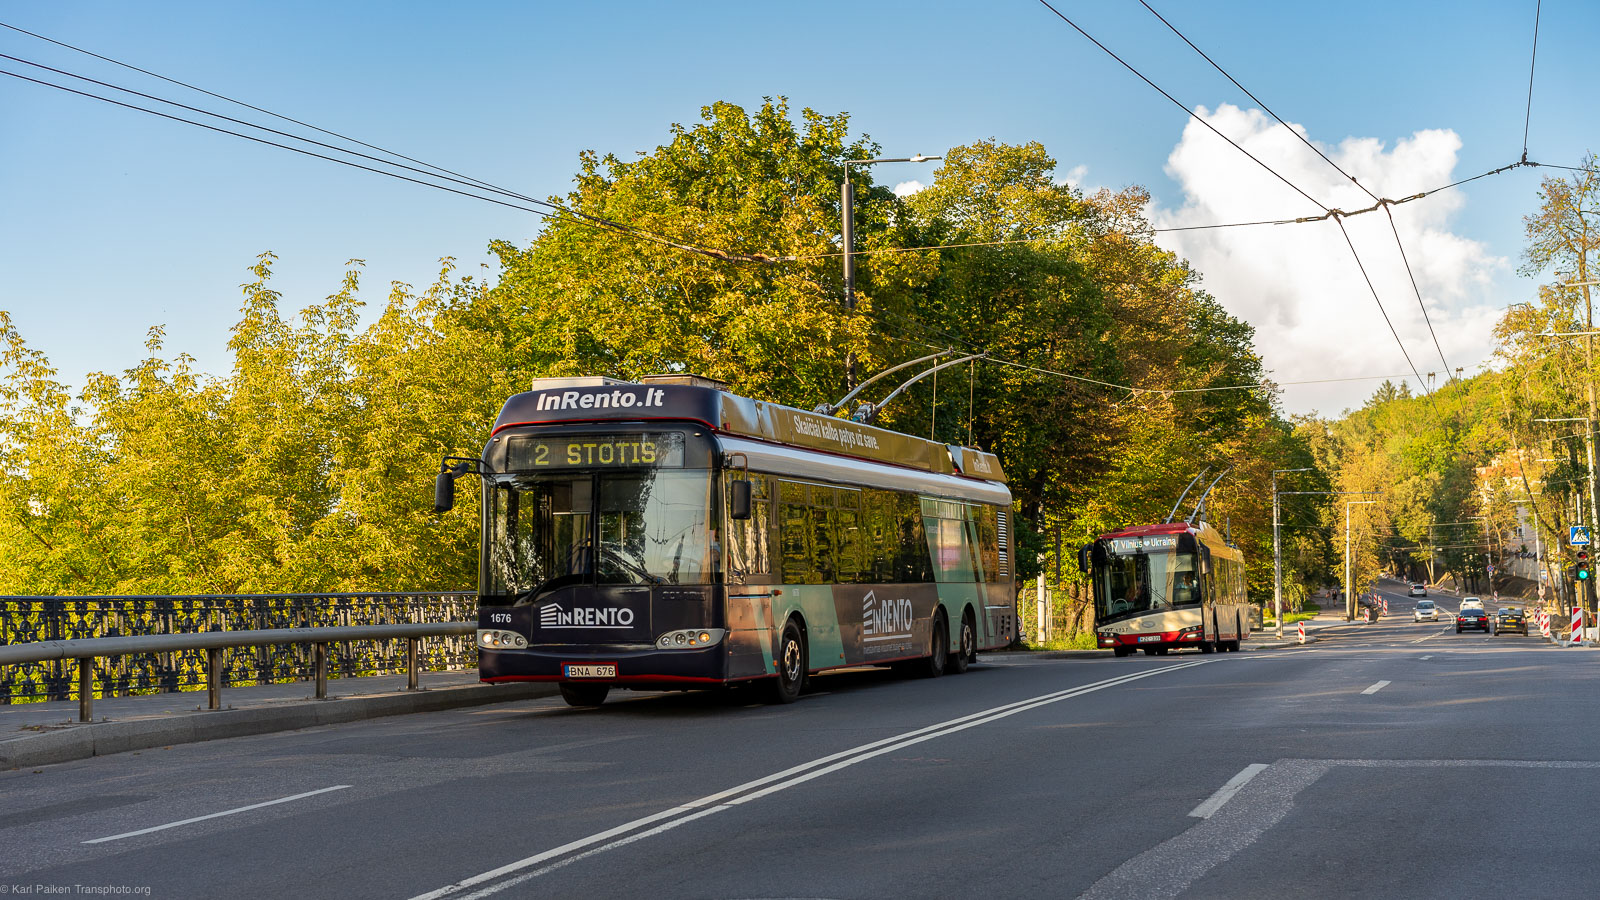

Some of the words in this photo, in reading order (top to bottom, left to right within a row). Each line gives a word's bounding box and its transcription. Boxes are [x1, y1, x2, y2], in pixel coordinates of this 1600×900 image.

[536, 387, 665, 411] InRento.lt
[838, 427, 856, 449] patys
[863, 433, 880, 450] save.
[535, 444, 550, 466] 2
[567, 442, 657, 465] STOTIS
[1109, 540, 1119, 553] 17
[1120, 539, 1143, 550] Vilnius
[1150, 537, 1176, 548] Ukraina
[490, 613, 512, 624] 1676
[570, 666, 591, 677] BNA
[596, 666, 614, 677] 676
